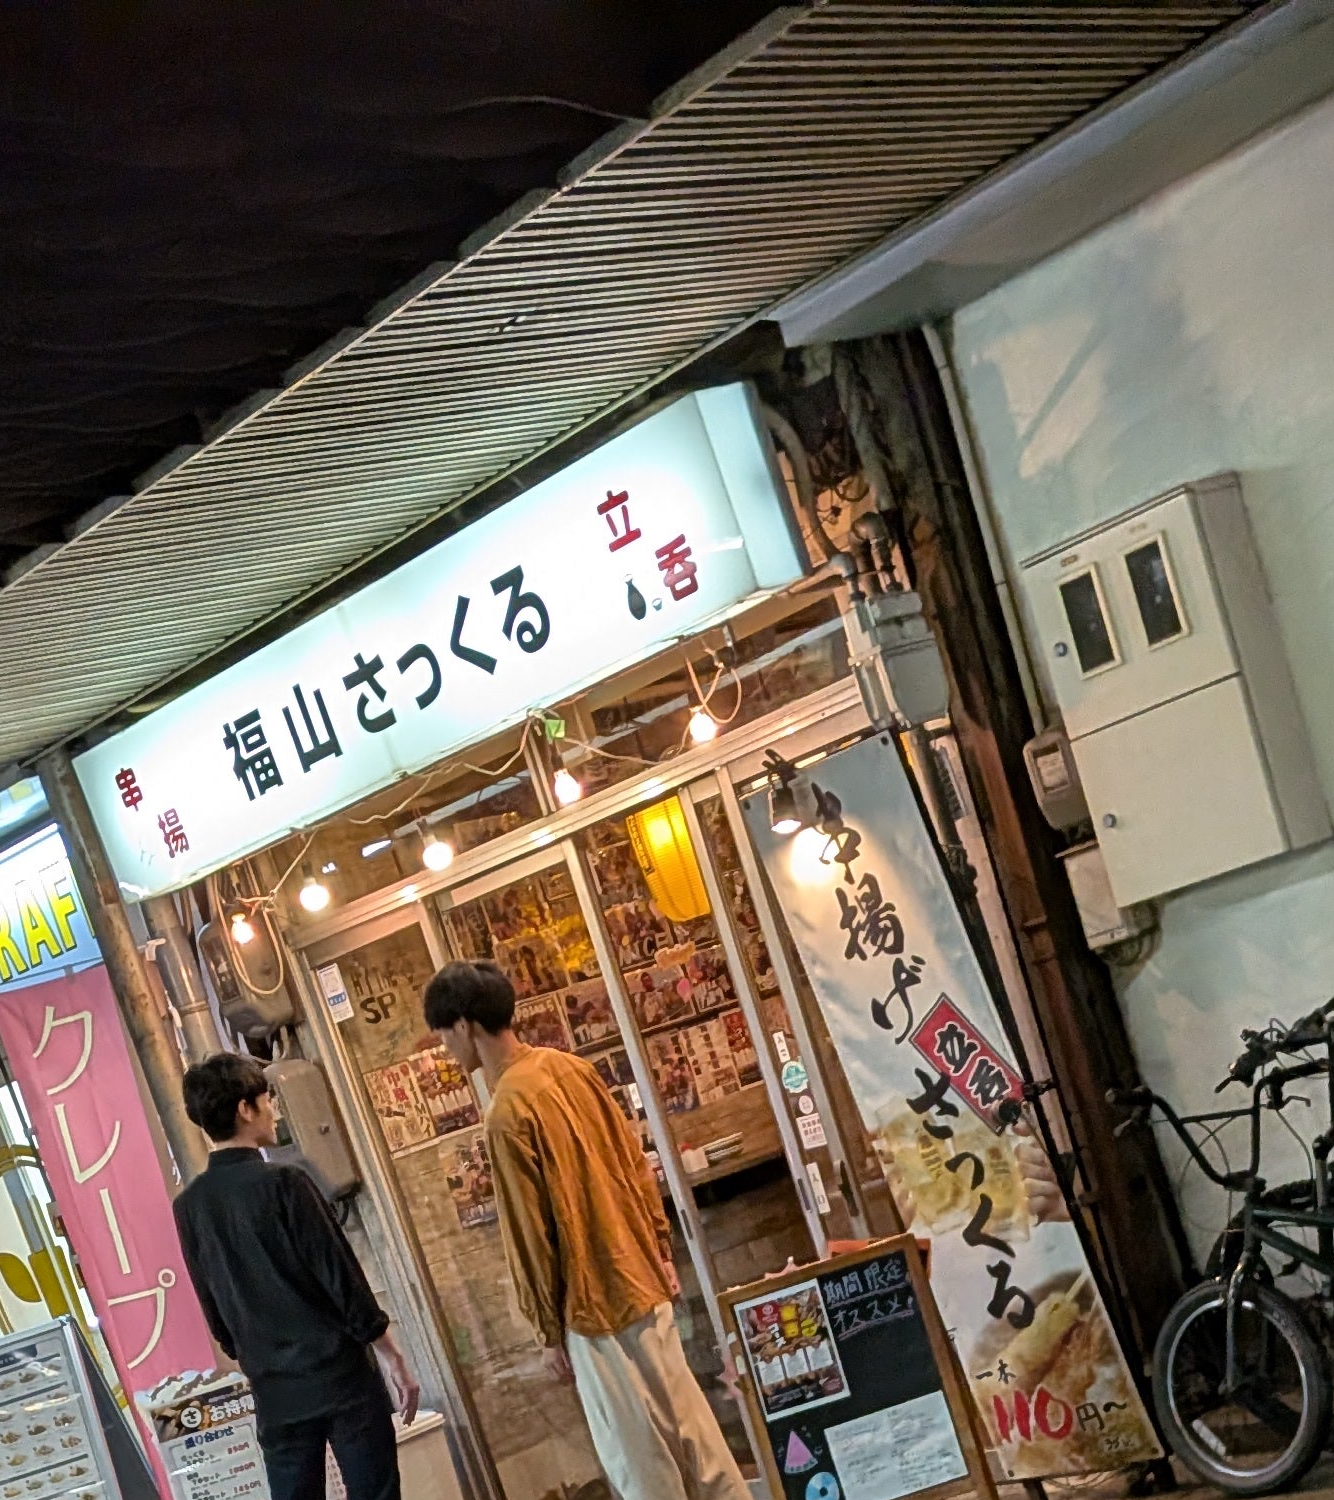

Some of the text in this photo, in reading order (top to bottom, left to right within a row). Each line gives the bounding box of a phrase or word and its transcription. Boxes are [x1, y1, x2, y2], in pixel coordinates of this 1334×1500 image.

[597, 489, 700, 602] 立呑
[221, 564, 553, 804] 福山さっくる
[113, 766, 190, 860] 串揚
[31, 1003, 177, 1370] クレープ
[906, 1067, 1036, 1330] さっくる
[822, 1257, 908, 1305] 期間限定
[974, 1357, 1018, 1388] 一本
